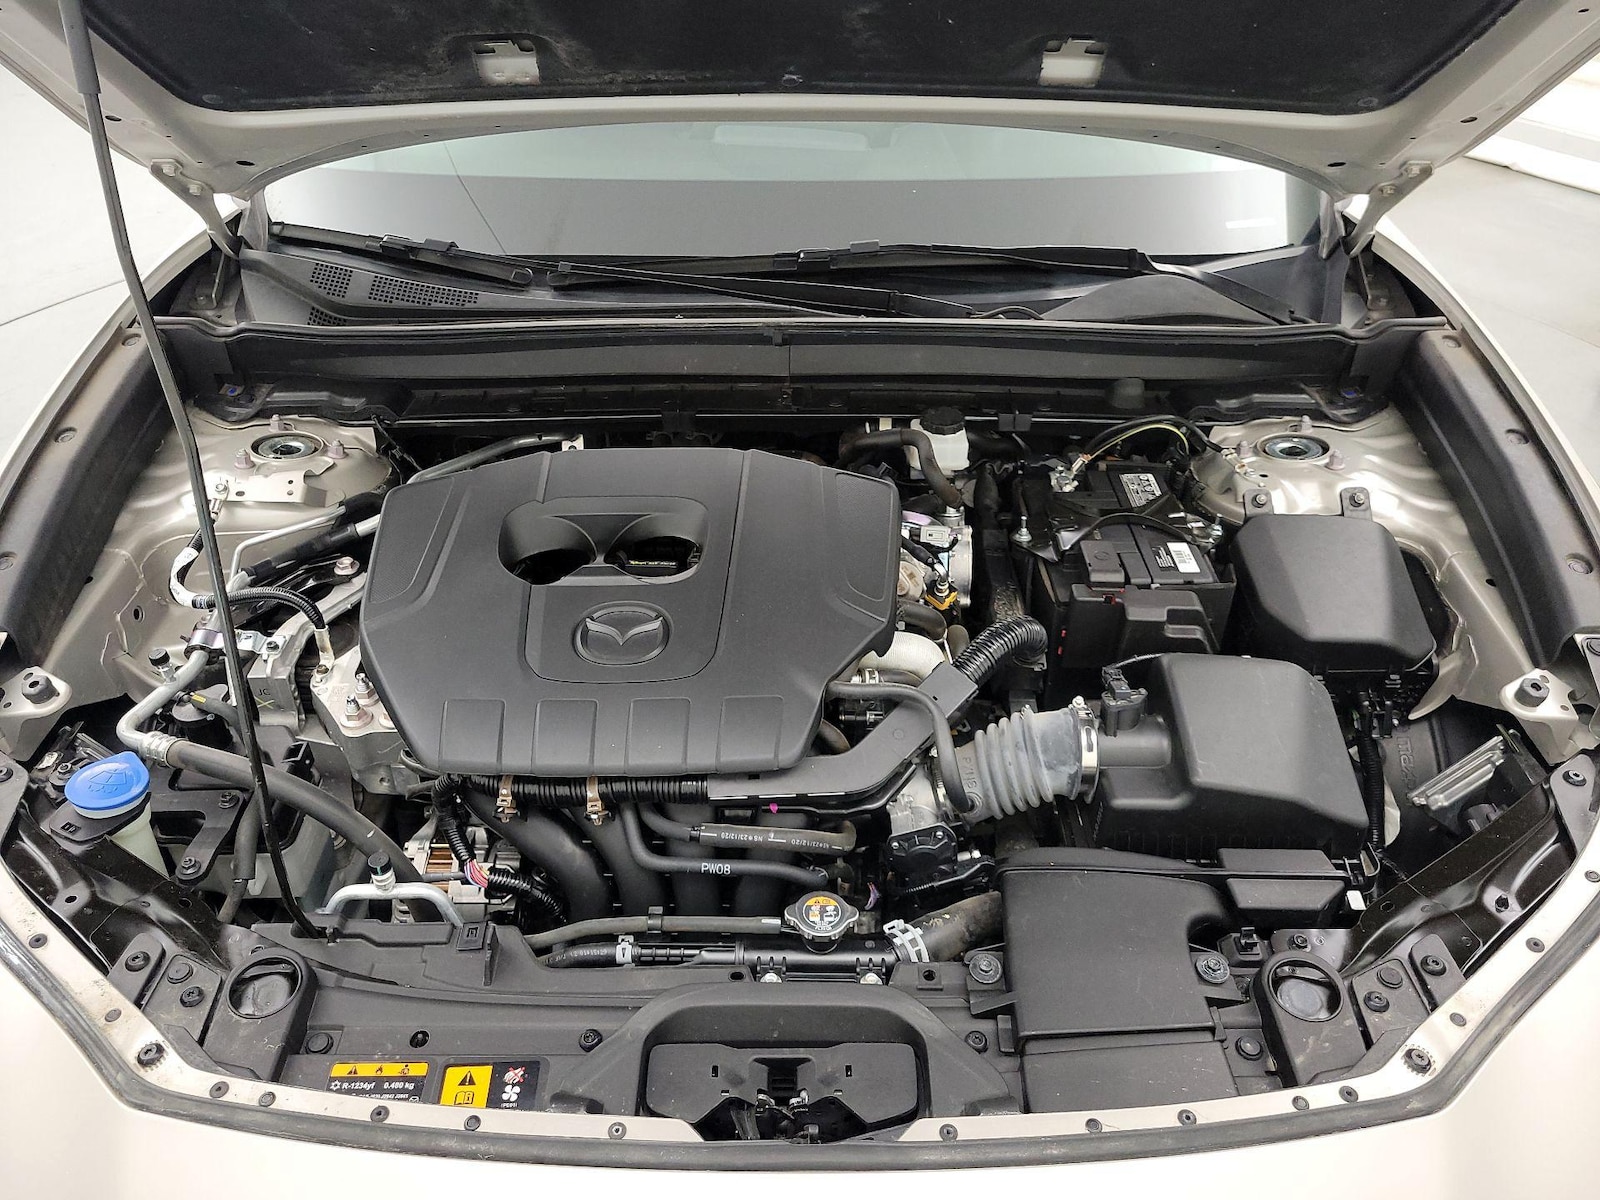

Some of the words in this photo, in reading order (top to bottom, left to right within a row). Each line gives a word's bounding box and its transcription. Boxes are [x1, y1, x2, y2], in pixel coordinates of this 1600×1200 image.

[701, 862, 731, 875] PW08
[342, 1081, 375, 1090] R-1234yf
[405, 1081, 415, 1090] kg
